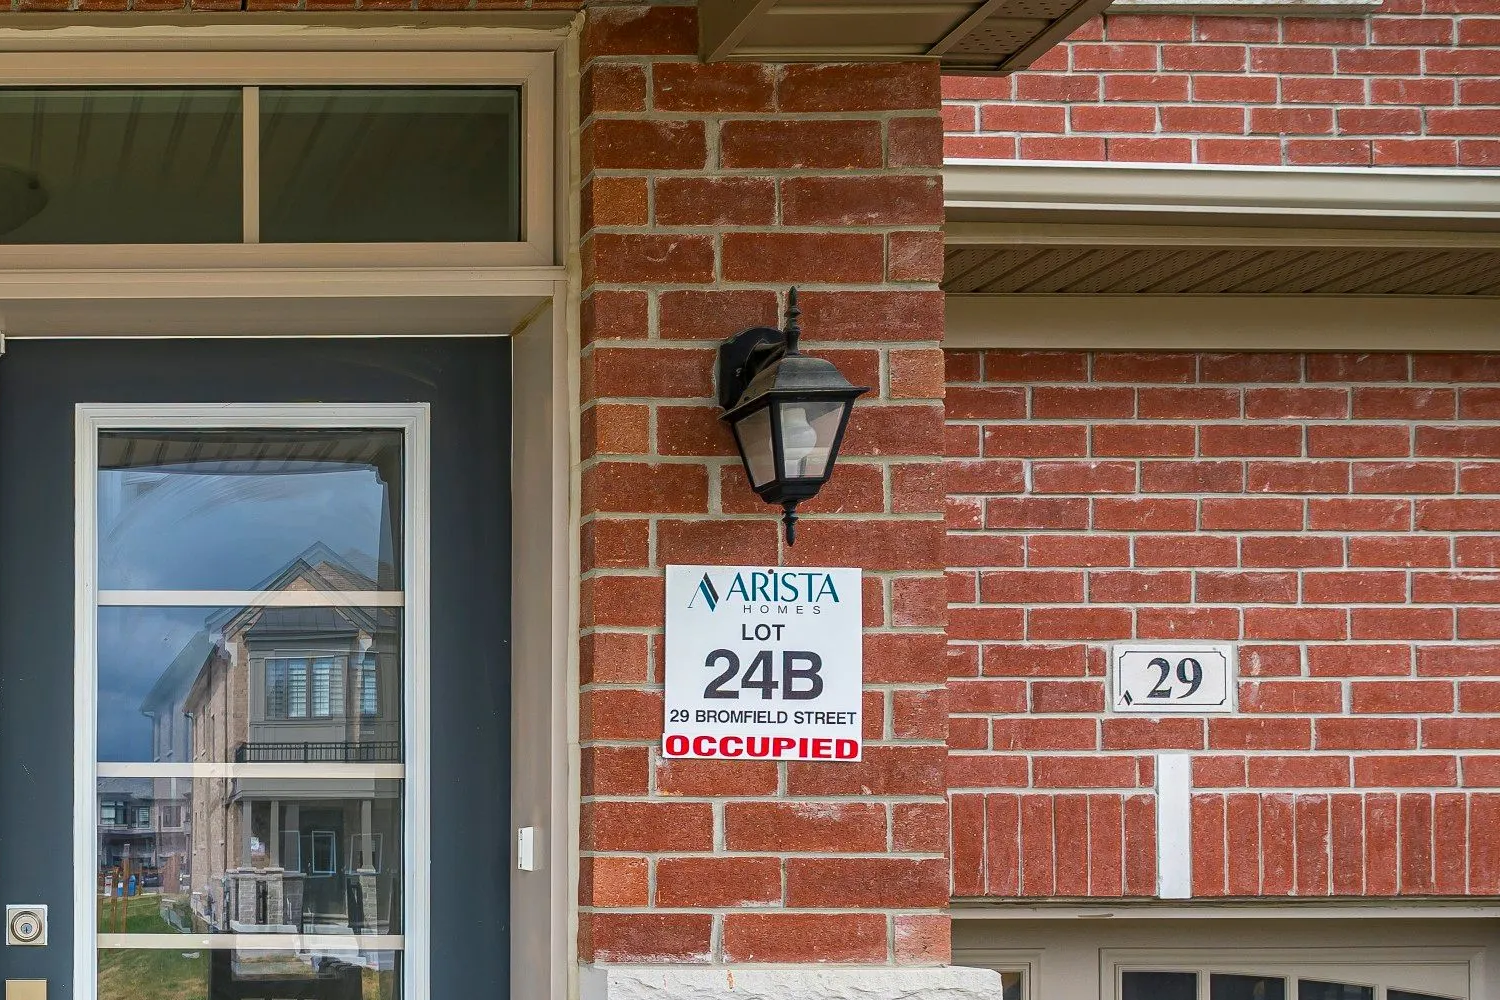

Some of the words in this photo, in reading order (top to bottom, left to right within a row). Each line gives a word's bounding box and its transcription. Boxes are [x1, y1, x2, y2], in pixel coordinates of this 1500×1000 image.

[726, 571, 840, 603] ARISTA
[743, 604, 821, 615] HOMES
[741, 623, 786, 641] LOT
[703, 648, 825, 701] 24B
[1146, 657, 1203, 699] 29
[669, 709, 690, 723] 29
[695, 710, 788, 725] BROMFIELD
[793, 711, 857, 725] STREET
[665, 735, 859, 760] OCCUPIED
